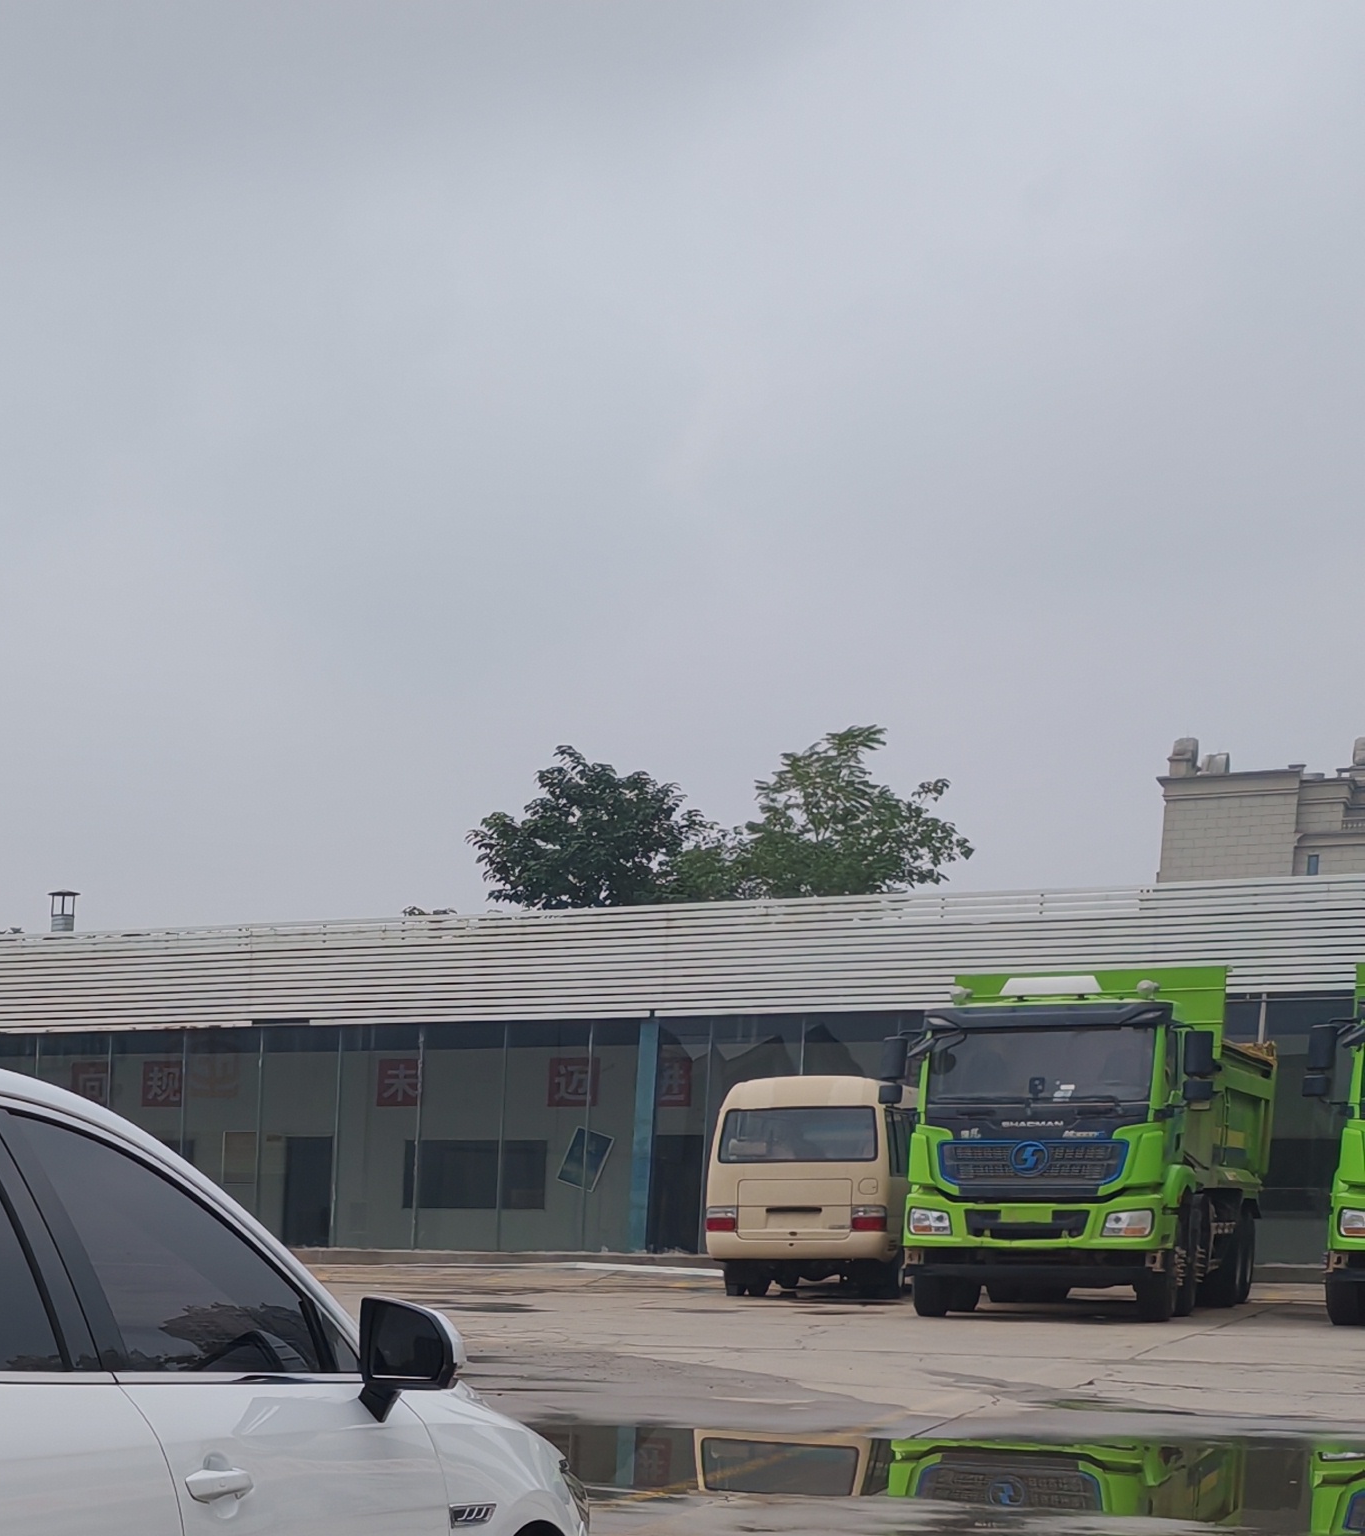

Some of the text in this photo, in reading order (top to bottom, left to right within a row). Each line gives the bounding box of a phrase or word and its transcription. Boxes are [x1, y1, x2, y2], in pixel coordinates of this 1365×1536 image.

[146, 1066, 181, 1102] 规
[554, 1064, 592, 1101] 迈
[1001, 1120, 1064, 1128] SHACMAN
